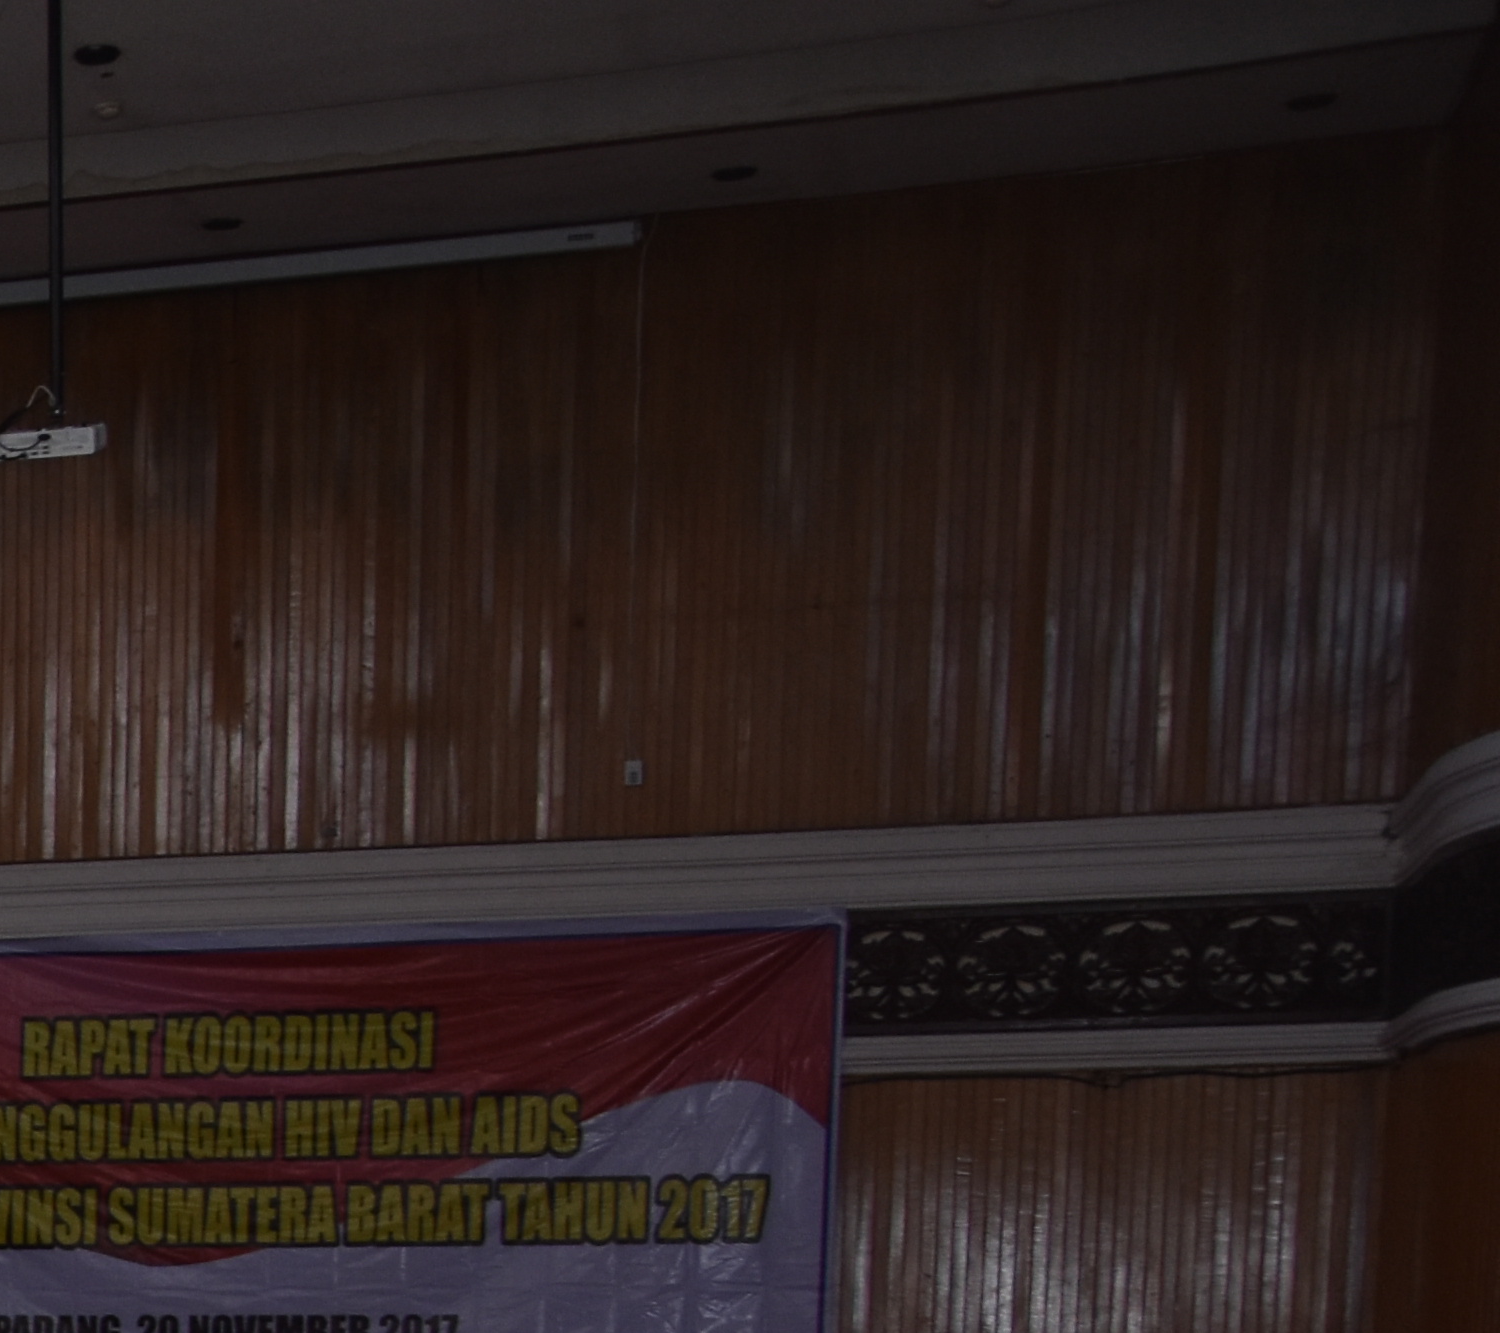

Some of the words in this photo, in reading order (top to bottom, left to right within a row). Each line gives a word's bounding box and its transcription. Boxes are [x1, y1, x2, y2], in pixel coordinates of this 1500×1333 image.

[22, 1016, 156, 1079] RAPAT
[162, 1010, 436, 1076] KOORDINASI
[283, 1097, 363, 1159] HIV
[370, 1094, 463, 1159] DAN
[469, 1092, 583, 1157] AIDS
[106, 1182, 338, 1247] SUMATERA
[344, 1179, 492, 1246] BARAT
[498, 1176, 651, 1245] TAHUN
[655, 1174, 771, 1243] 2017
